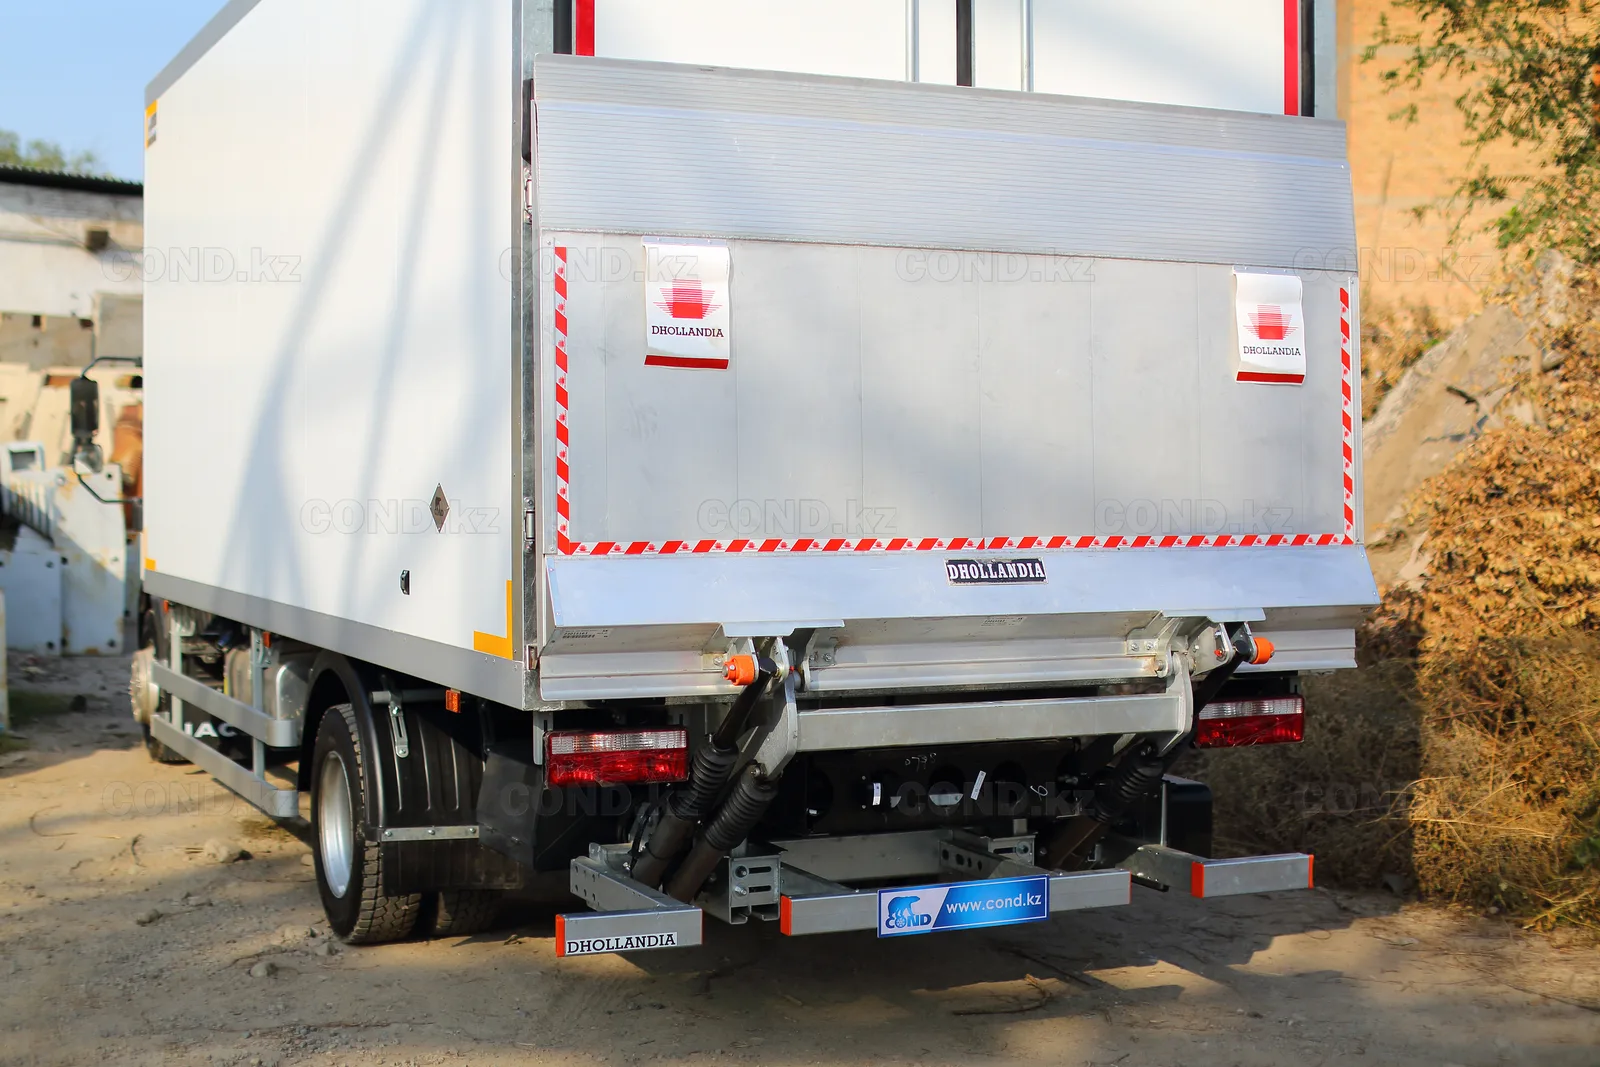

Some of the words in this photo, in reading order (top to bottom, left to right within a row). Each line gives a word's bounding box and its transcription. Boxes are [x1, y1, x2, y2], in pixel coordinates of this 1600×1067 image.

[651, 325, 725, 338] DHOLLANDIA
[1243, 345, 1302, 356] DHOLLANDIA
[946, 562, 1045, 579] DHOLLANDIA
[946, 893, 1042, 914] www.cond.kz
[885, 913, 932, 928] COND
[567, 934, 676, 953] DHOLLANDIA
